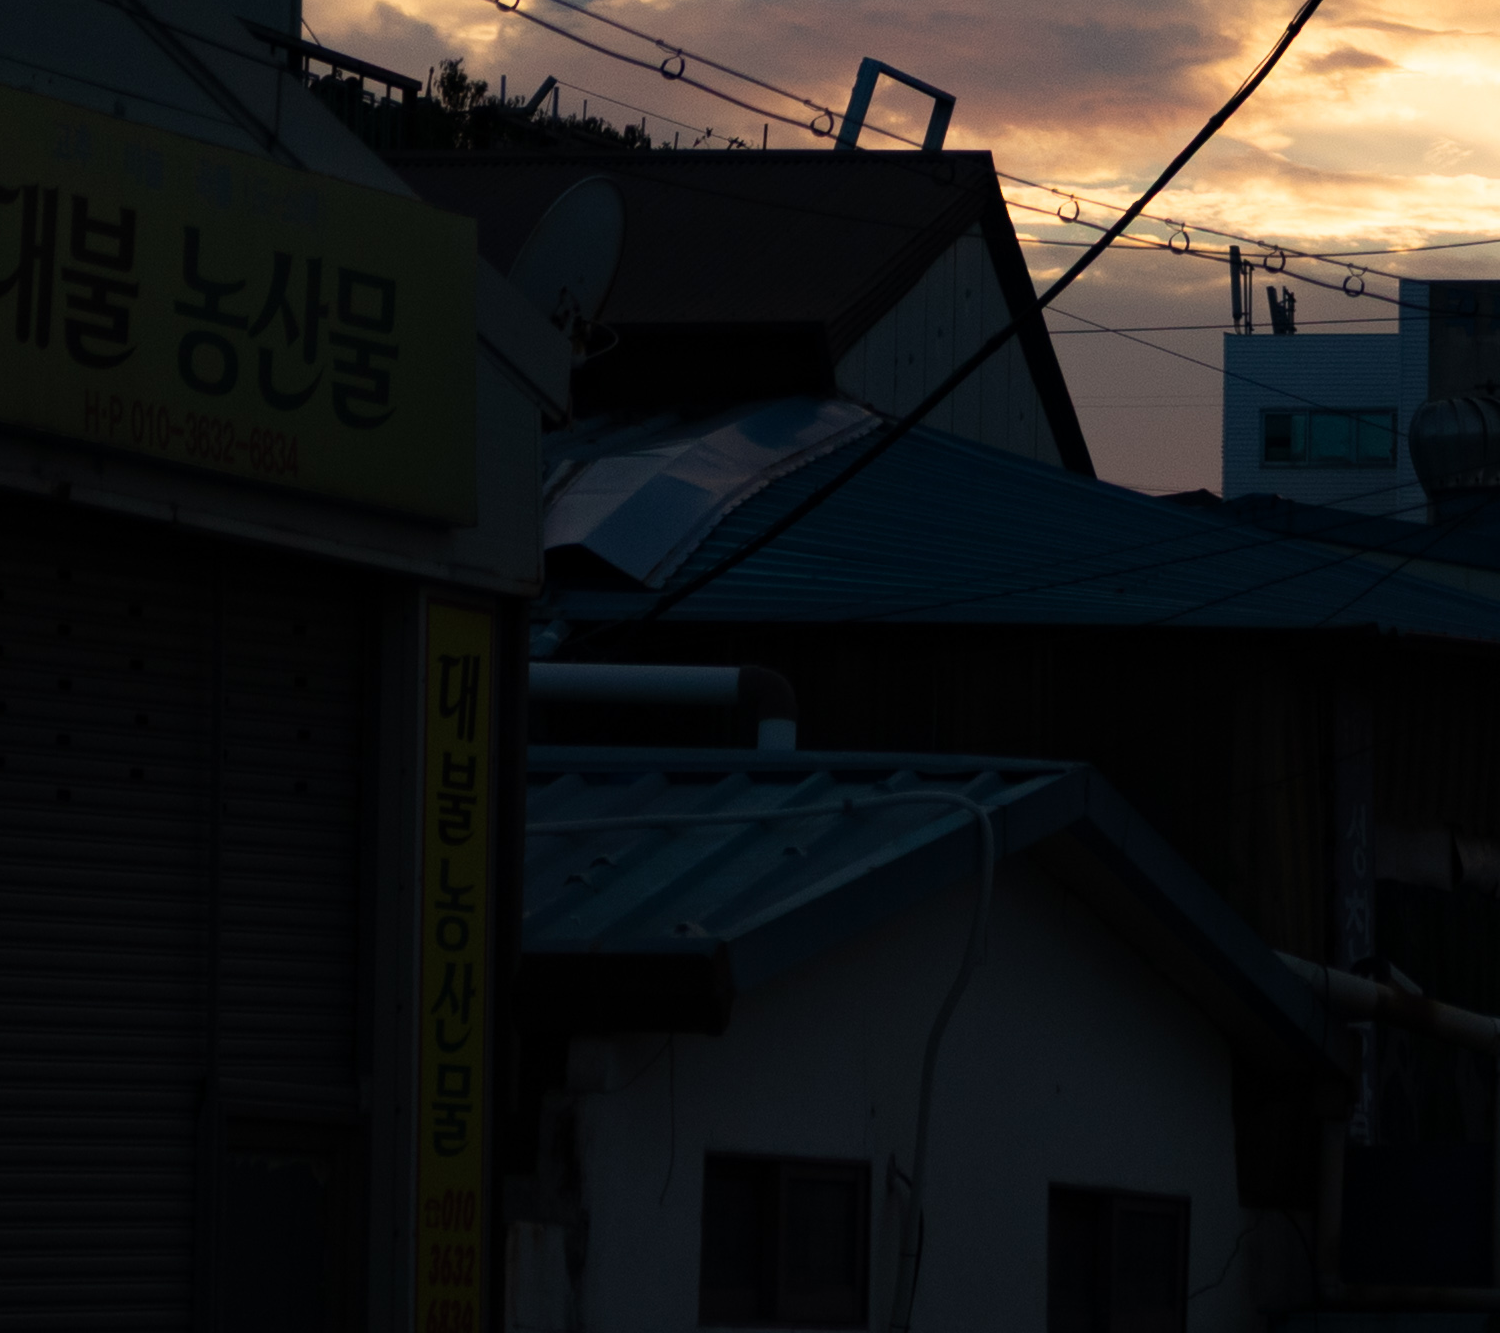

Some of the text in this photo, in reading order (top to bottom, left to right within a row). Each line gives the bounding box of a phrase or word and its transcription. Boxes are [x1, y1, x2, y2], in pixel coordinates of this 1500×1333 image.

[172, 224, 401, 431] 농산물
[130, 404, 300, 478] 010-3632-6834
[440, 1189, 475, 1230] 010
[428, 1244, 475, 1287] 3632
